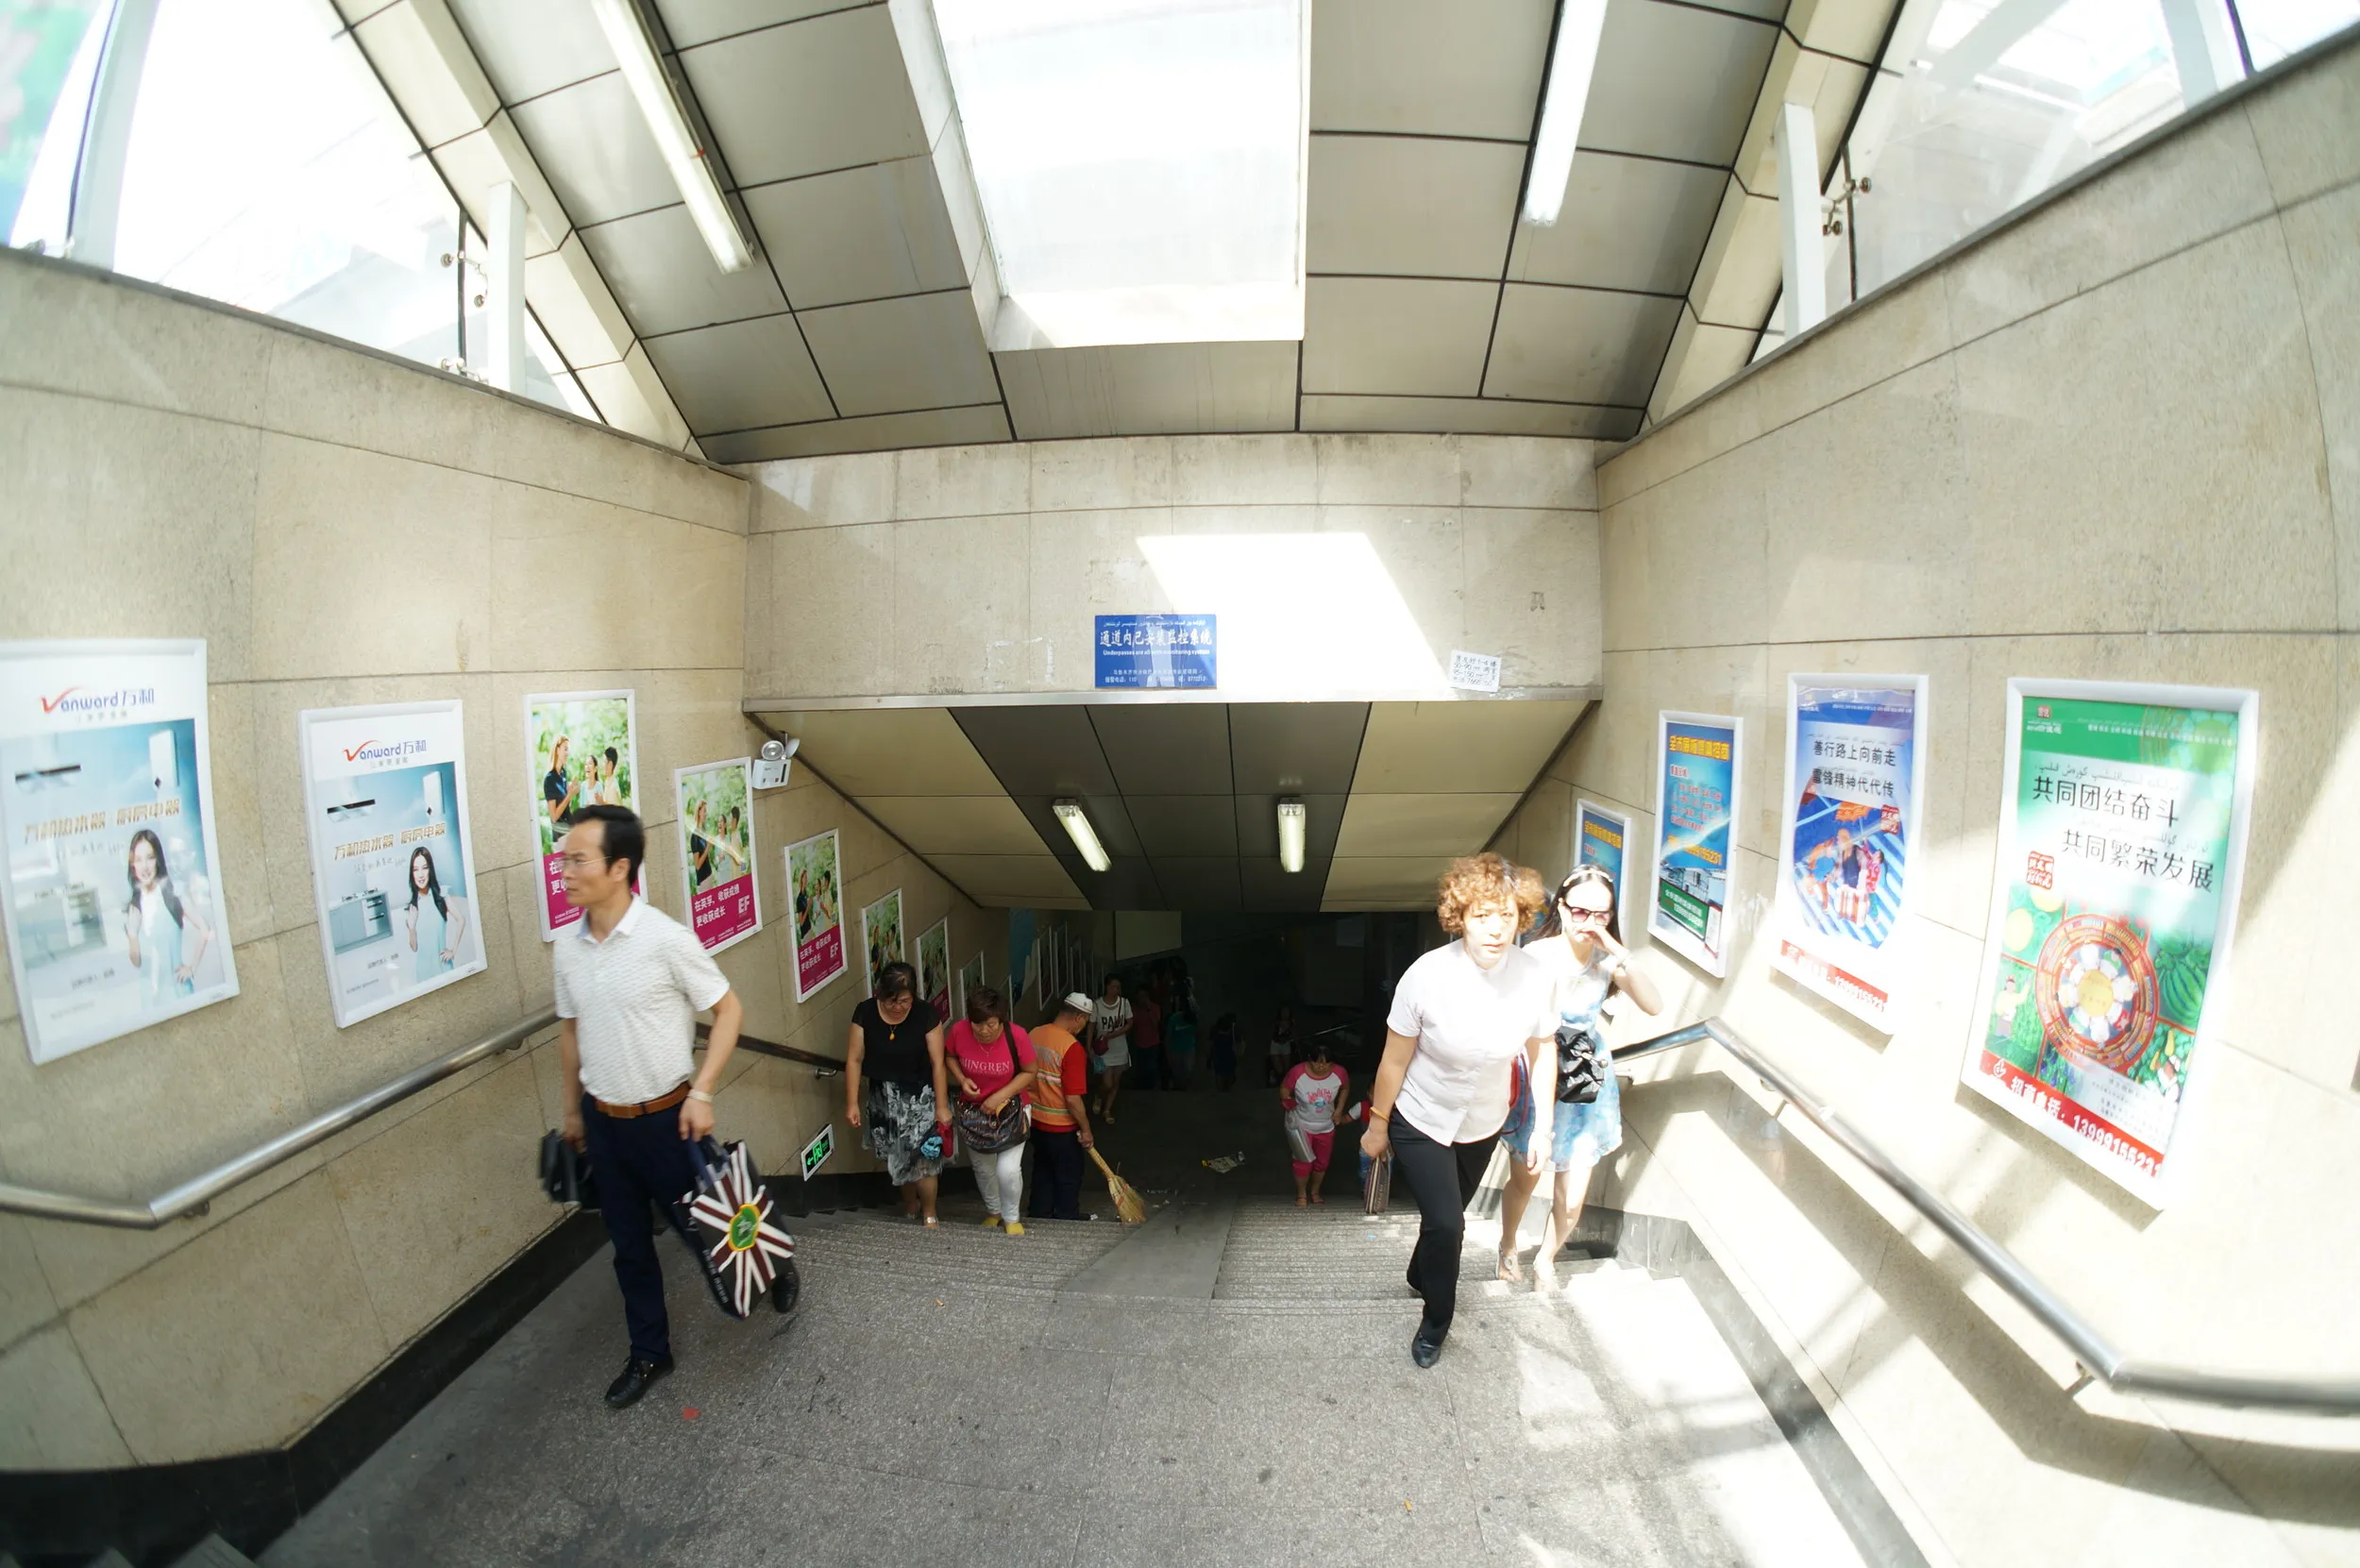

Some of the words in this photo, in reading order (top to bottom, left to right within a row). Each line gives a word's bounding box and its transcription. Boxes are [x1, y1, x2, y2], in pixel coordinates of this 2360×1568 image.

[1100, 628, 1213, 647] 通道内已安装监控系统
[40, 685, 119, 714] Vanward
[342, 739, 401, 761] Vanward
[403, 739, 428, 754] 万和
[1813, 739, 1896, 767] 善行路上向前走
[1812, 767, 1895, 799] 雷锋精神代代传
[2031, 775, 2180, 829] 共同团结奋斗
[2061, 828, 2215, 893] 共同繁荣发展
[738, 894, 750, 915] EF
[830, 941, 839, 959] EF
